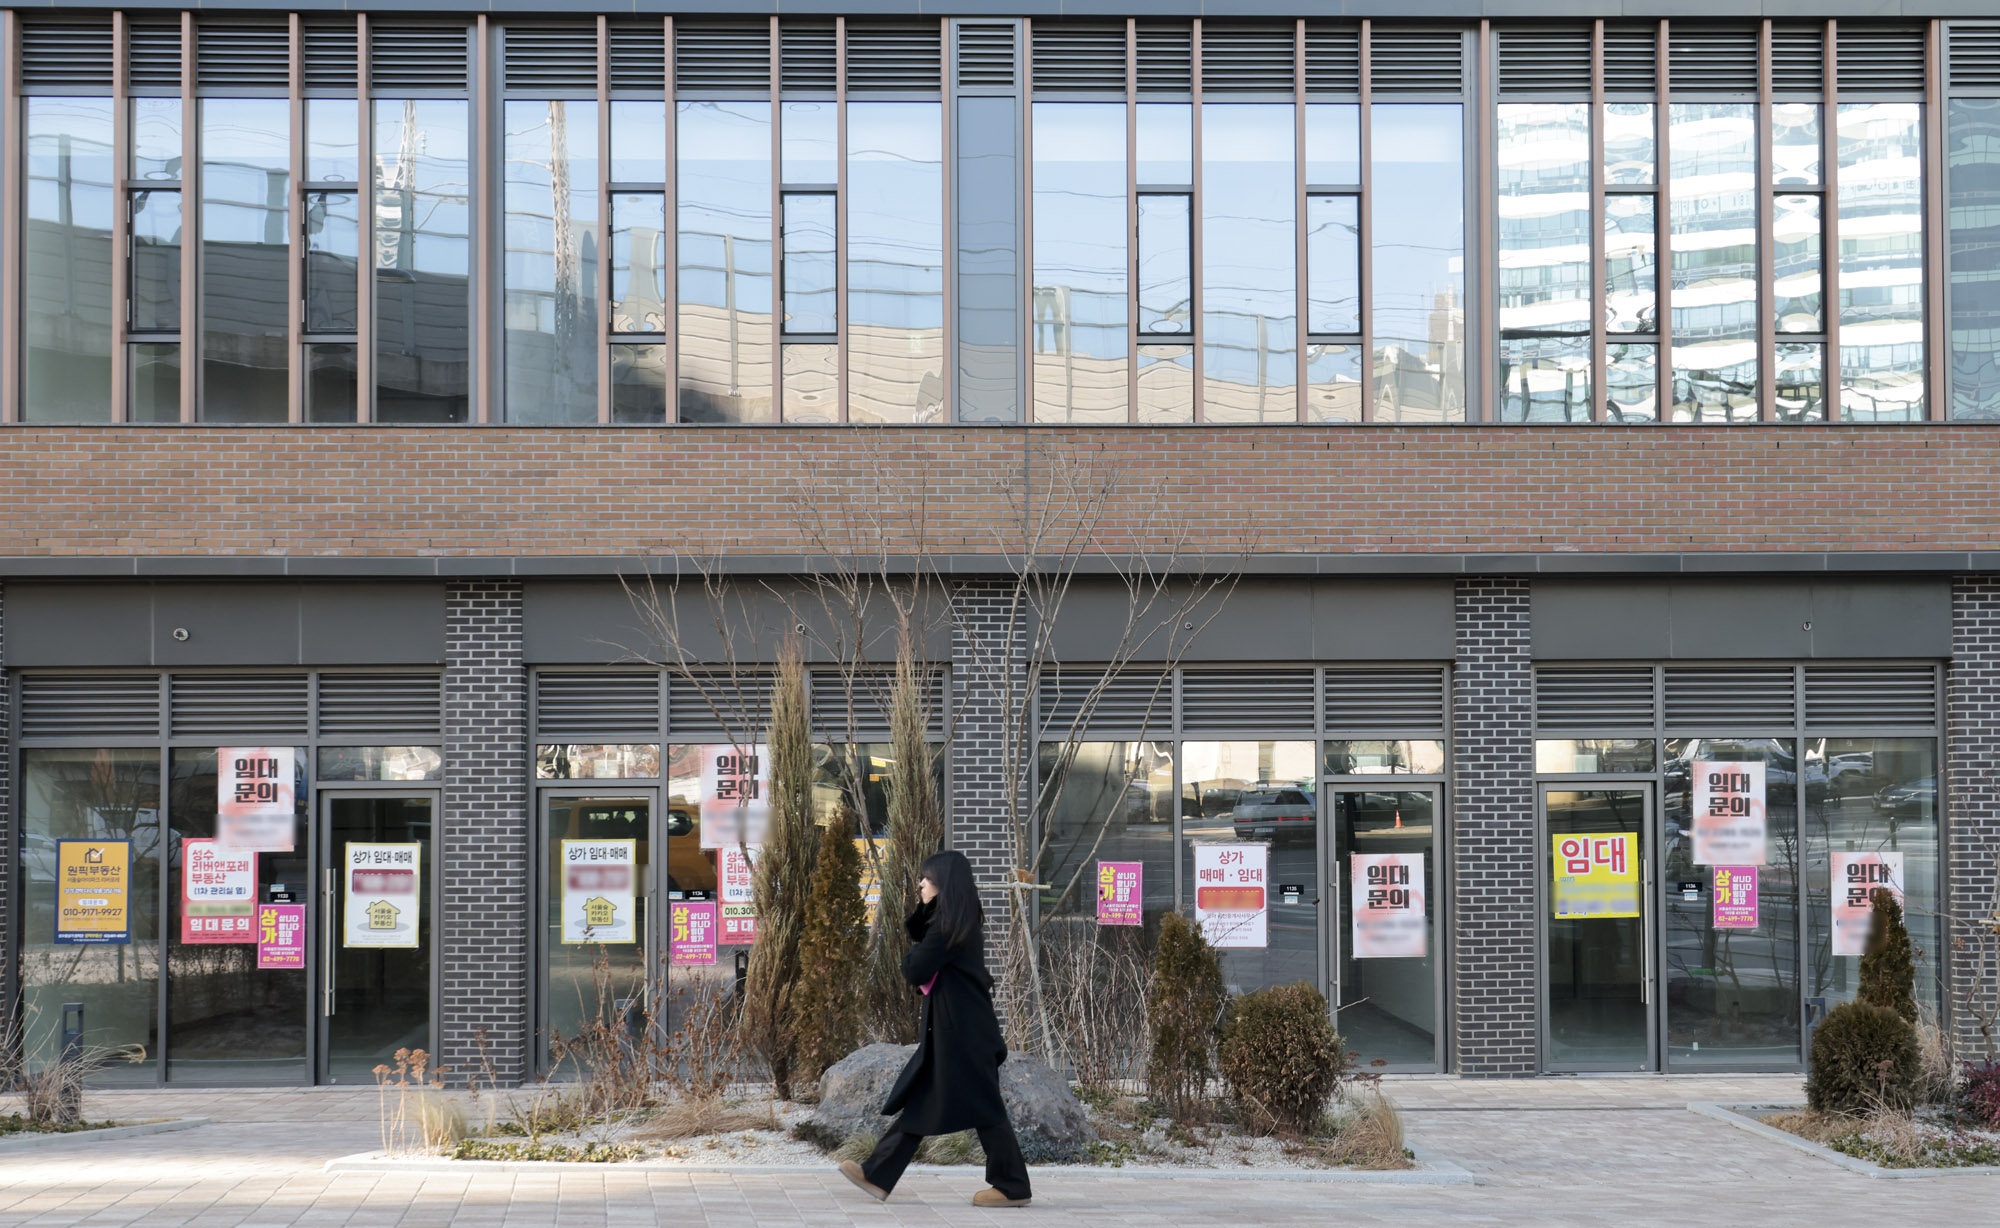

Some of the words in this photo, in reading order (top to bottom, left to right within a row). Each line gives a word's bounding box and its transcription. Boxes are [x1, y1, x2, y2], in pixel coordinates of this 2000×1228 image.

[234, 758, 278, 778] 임대
[716, 755, 759, 775] 임대
[716, 780, 759, 800] 문의
[1708, 772, 1751, 793] 임대
[234, 783, 278, 803] 문의
[1708, 797, 1751, 817] 문의
[192, 849, 214, 861] 성수
[352, 850, 371, 864] 상가
[568, 847, 587, 860] 상가
[1218, 850, 1244, 865] 상가
[1561, 837, 1626, 874] 임대
[67, 865, 121, 876] 원픽부동산
[192, 861, 249, 872] 리버앤포레
[1847, 863, 1889, 883] 임대
[192, 873, 226, 884] 부동산
[727, 875, 753, 886] 부동
[1117, 872, 1136, 880] 삽니다
[1200, 868, 1224, 882] 매매
[1237, 868, 1262, 882] 임대
[1367, 865, 1410, 885] 임대
[194, 887, 207, 895] (1차
[210, 887, 233, 895] 관리실
[1716, 869, 1732, 904] 상가
[1367, 888, 1410, 909] 문의
[63, 908, 122, 916] 010-9171-9927
[690, 912, 710, 920] 삽니다
[190, 918, 250, 931] 임대문의
[261, 909, 278, 944] 상가
[673, 907, 690, 942] 상가
